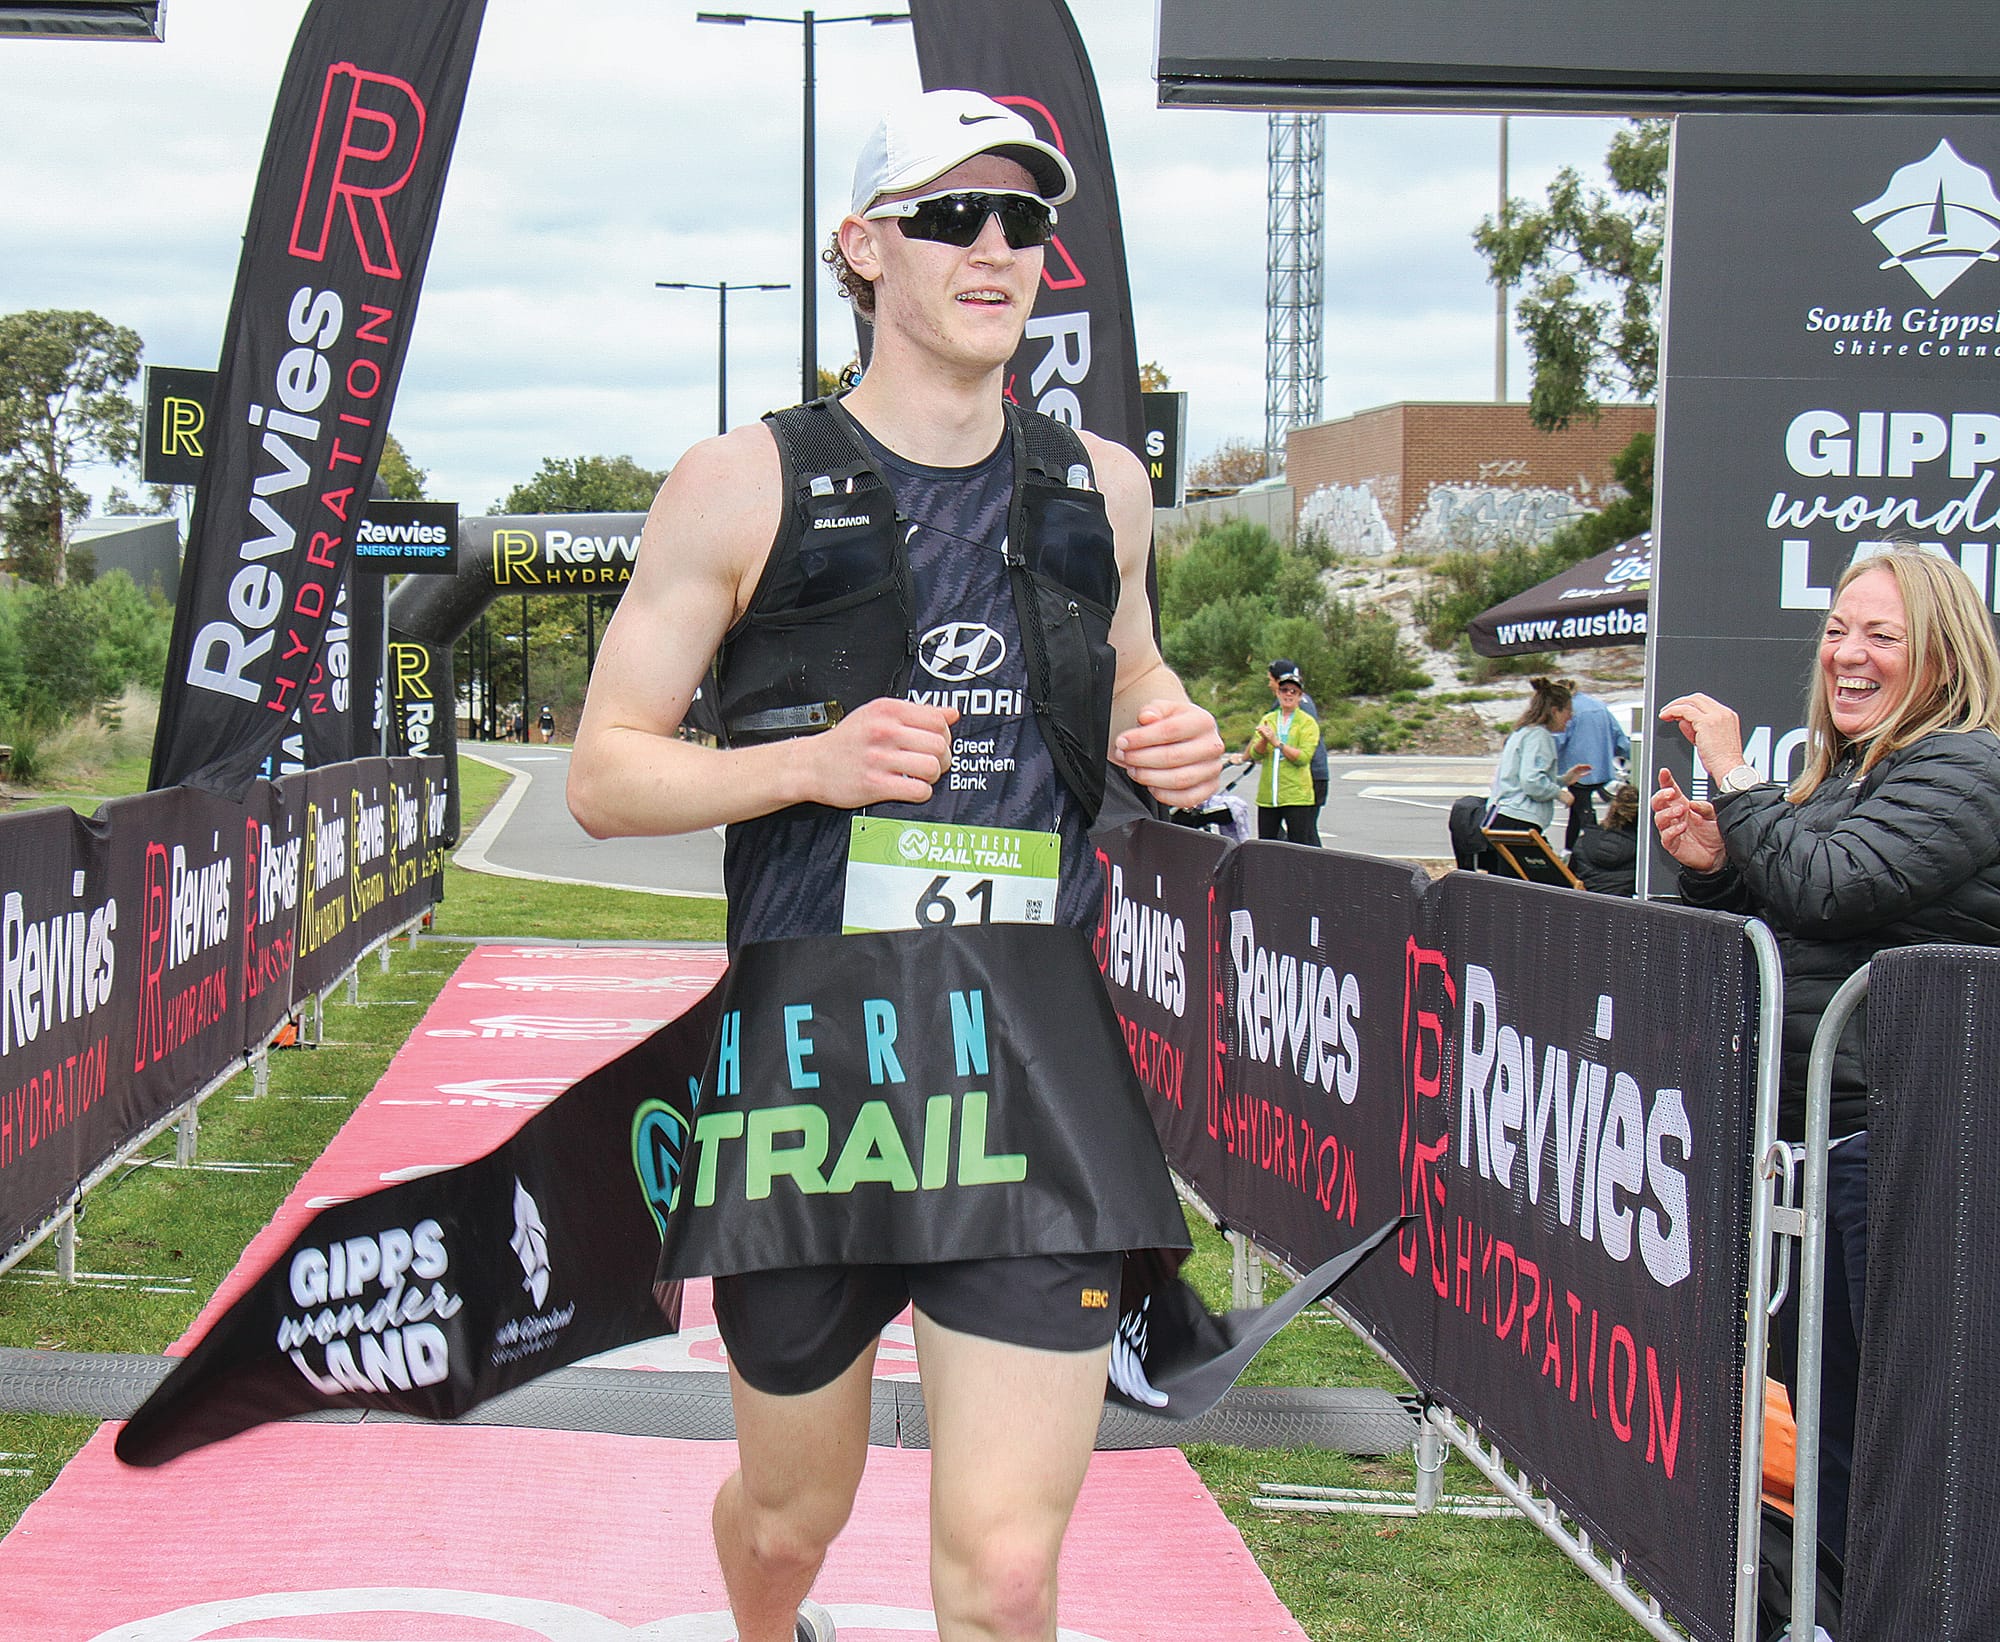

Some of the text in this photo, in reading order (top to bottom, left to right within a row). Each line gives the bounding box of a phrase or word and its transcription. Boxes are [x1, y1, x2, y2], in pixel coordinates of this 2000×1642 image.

[1806, 307, 1892, 332] South
[1833, 340, 1909, 356] Shire
[1785, 410, 2000, 479] GIPP
[186, 286, 344, 703] Revvies
[266, 303, 394, 713] HYDRATION
[814, 515, 870, 530] SALOMON
[356, 519, 447, 544] Revvies
[356, 545, 401, 558] ENERGY
[547, 568, 631, 584] HYDRA
[1496, 608, 1647, 646] www.austba
[950, 756, 1016, 773] Southern
[953, 738, 995, 754] Great
[950, 774, 987, 791] Bank
[927, 846, 1022, 868] RAIL TRAIL
[931, 831, 1021, 851] SOUTHERN
[169, 831, 231, 970] Revvies
[915, 875, 994, 928] 61
[3, 870, 117, 1056] Revvies
[1110, 864, 1187, 1018] Revvies
[165, 965, 228, 1057] HYDRATION
[717, 989, 990, 1097] HERN
[1230, 909, 1361, 1105] Revvies
[1, 1034, 108, 1169] HYDRATION
[1459, 964, 1692, 1288] Revvies
[694, 1091, 1028, 1208] TRAIL
[289, 1218, 450, 1308] GIPPS
[288, 1322, 450, 1397] LAND
[1456, 1215, 1682, 1481] HYDRATION
